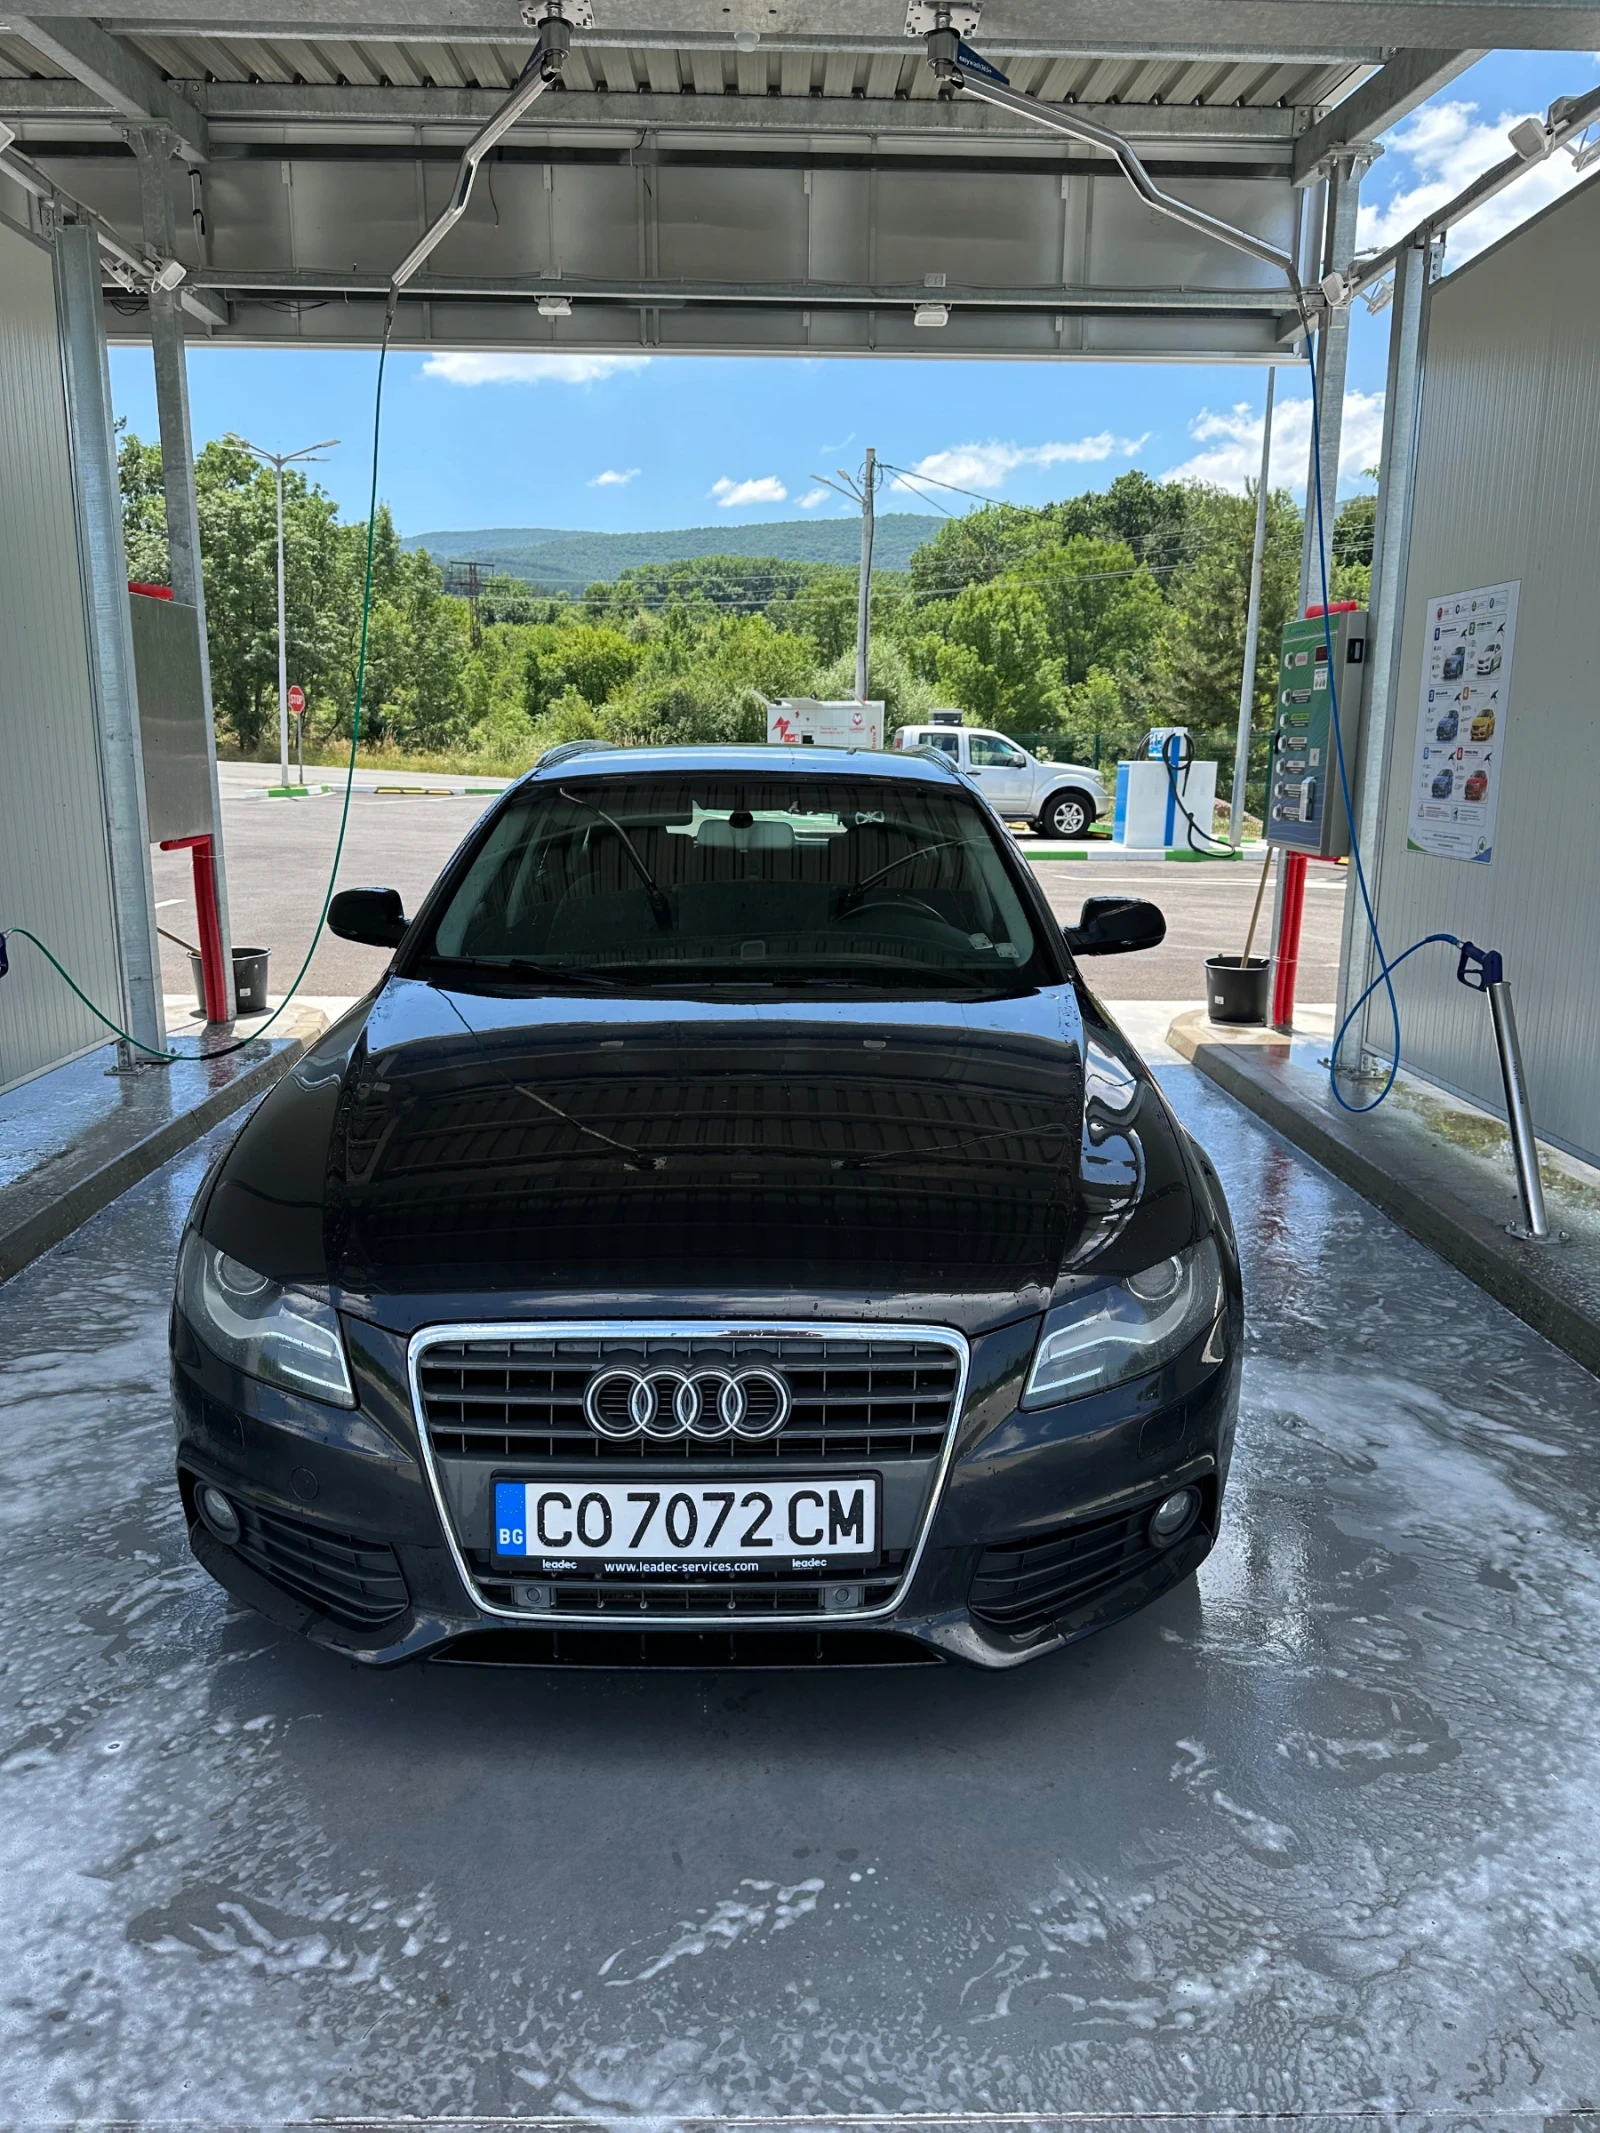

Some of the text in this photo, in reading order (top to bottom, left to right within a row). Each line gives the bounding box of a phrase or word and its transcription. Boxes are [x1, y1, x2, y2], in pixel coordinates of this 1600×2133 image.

[959, 56, 992, 73] easywash365+
[290, 694, 304, 704] STOP
[537, 1489, 864, 1548] CO 7072 CM
[500, 1529, 523, 1544] BG
[542, 1559, 578, 1570] leadec
[604, 1561, 759, 1573] www.leadec-services.com
[792, 1557, 827, 1568] leadec
